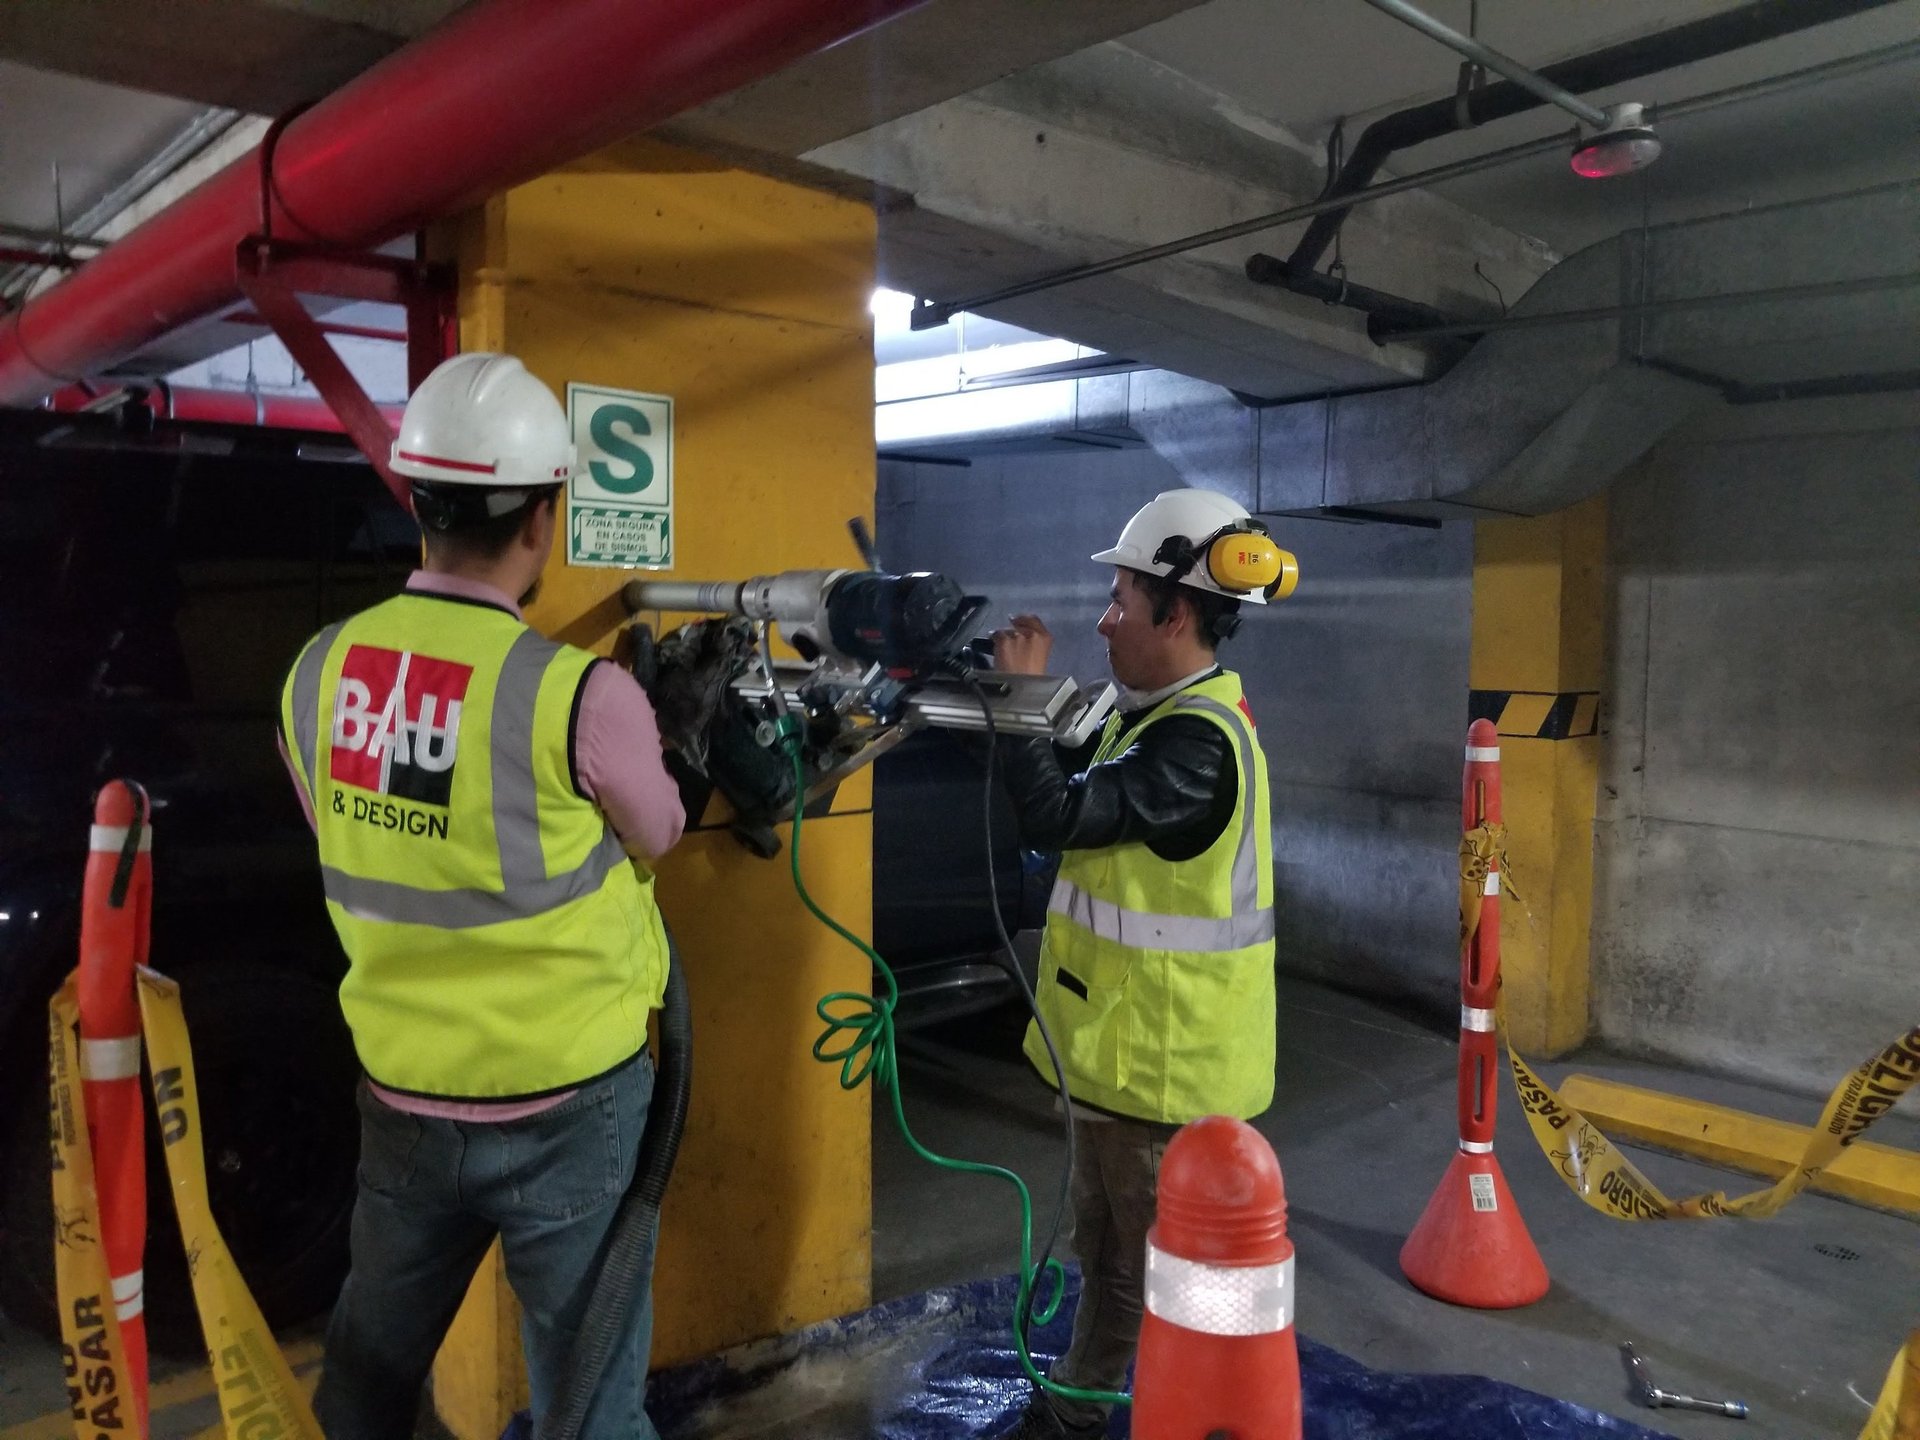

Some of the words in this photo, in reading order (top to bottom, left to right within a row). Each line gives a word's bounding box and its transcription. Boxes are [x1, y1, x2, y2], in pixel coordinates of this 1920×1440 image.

[588, 404, 655, 494] S
[585, 519, 612, 529] ZONA
[616, 521, 656, 531] SEGURA
[595, 542, 608, 551] DE
[611, 543, 648, 553] SISMOS
[596, 531, 610, 539] EN
[612, 532, 647, 541] CASOS
[1238, 551, 1246, 565] 3M
[333, 652, 463, 772] BAU
[333, 790, 346, 816] &
[353, 797, 450, 840] DESIGN
[1827, 1075, 1865, 1135] TRABAJANDO
[1600, 1170, 1667, 1220] LIGRO
